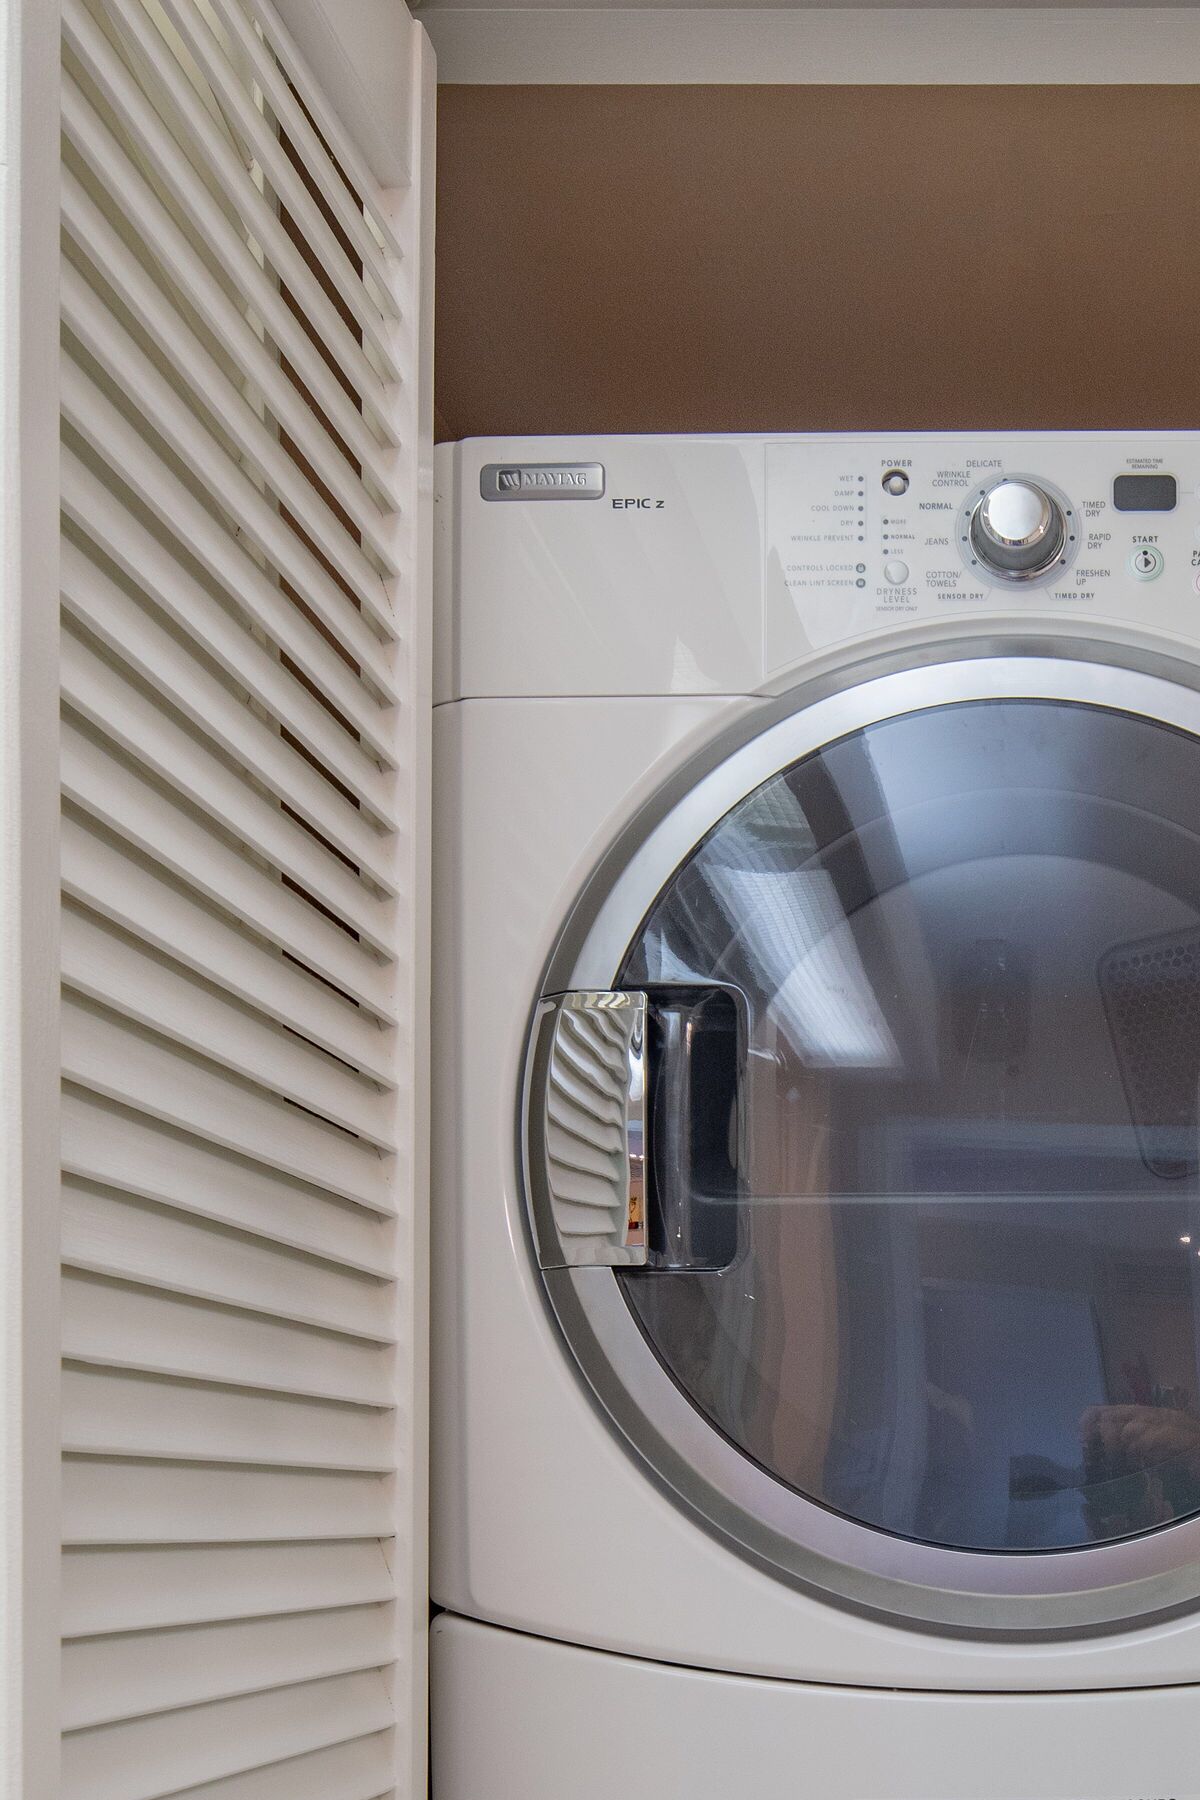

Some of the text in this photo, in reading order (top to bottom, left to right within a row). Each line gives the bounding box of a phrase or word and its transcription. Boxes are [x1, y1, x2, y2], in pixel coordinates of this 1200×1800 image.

[966, 460, 1002, 468] DELICATE
[524, 472, 587, 485] MAYTAG
[612, 498, 651, 509] EPIC
[1082, 501, 1106, 509] TIMED
[1088, 533, 1112, 541] RAPID
[1132, 535, 1158, 543] START
[924, 538, 949, 546] JEANS
[925, 571, 962, 579] COTTON/
[926, 580, 957, 588] TOWELS
[1076, 578, 1086, 586] UP
